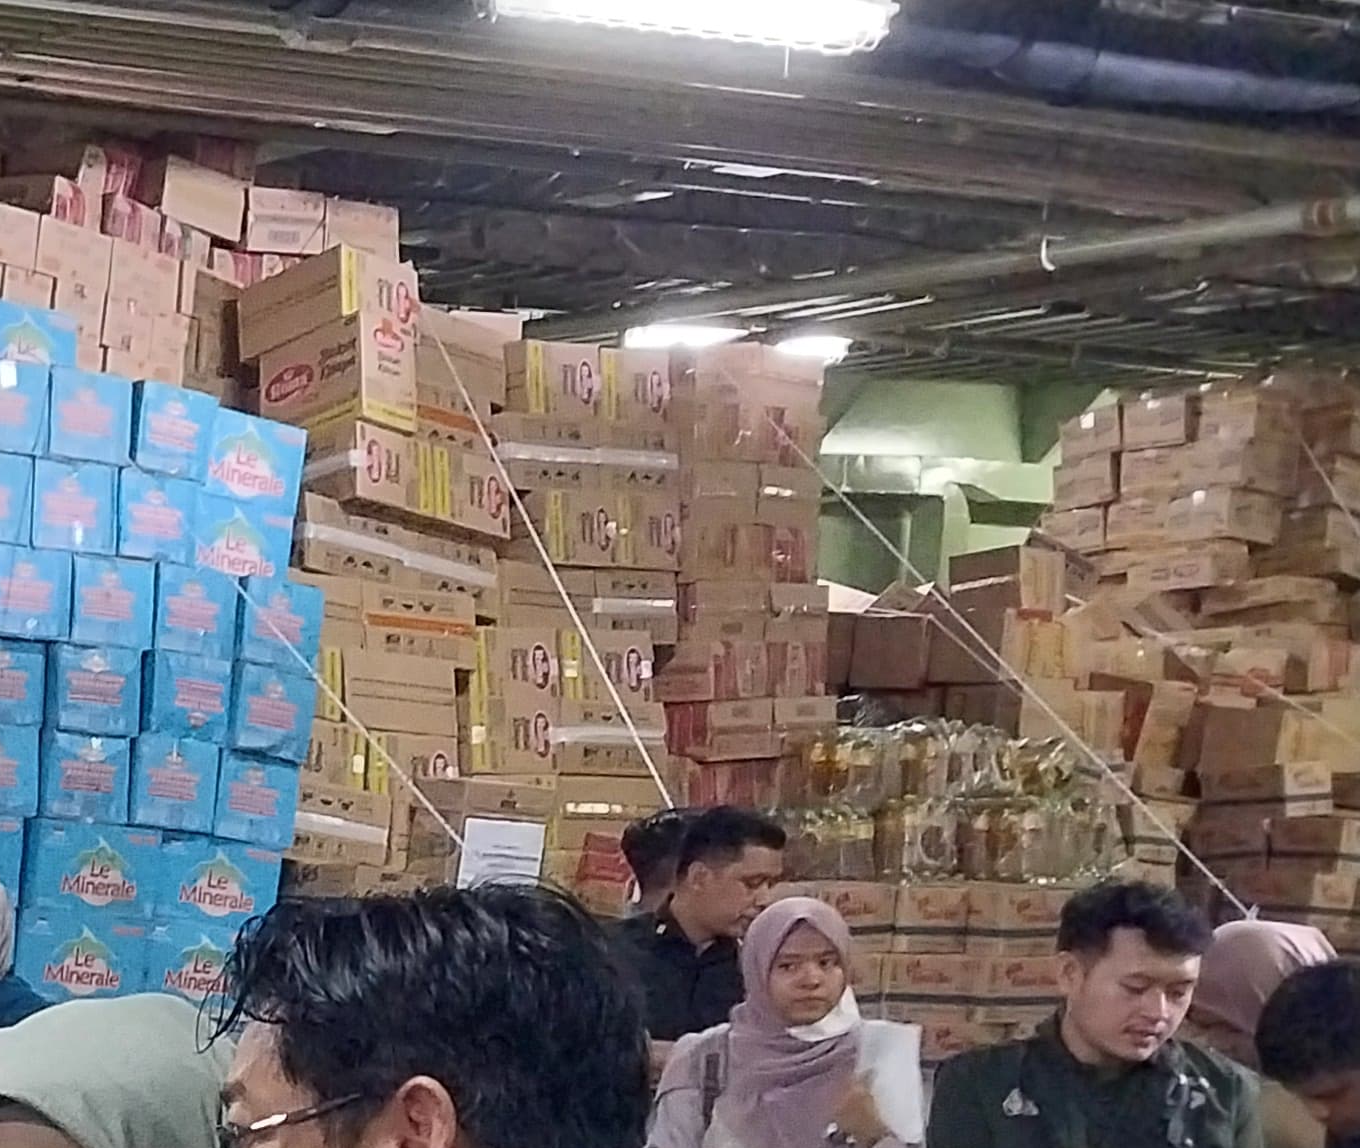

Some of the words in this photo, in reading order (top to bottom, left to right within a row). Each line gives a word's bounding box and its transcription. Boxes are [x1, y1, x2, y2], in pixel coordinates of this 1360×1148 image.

[239, 444, 258, 467] Le
[208, 456, 285, 497] Minerale
[225, 530, 247, 550] Le
[197, 542, 274, 577] Minerale
[90, 859, 111, 879] Le
[206, 871, 229, 891] Le
[60, 874, 136, 900] Minerale
[179, 882, 254, 914] Minerale
[74, 947, 96, 968] Le
[193, 953, 213, 974] Le
[44, 962, 121, 989] Minerale
[165, 969, 233, 994] Mineral
